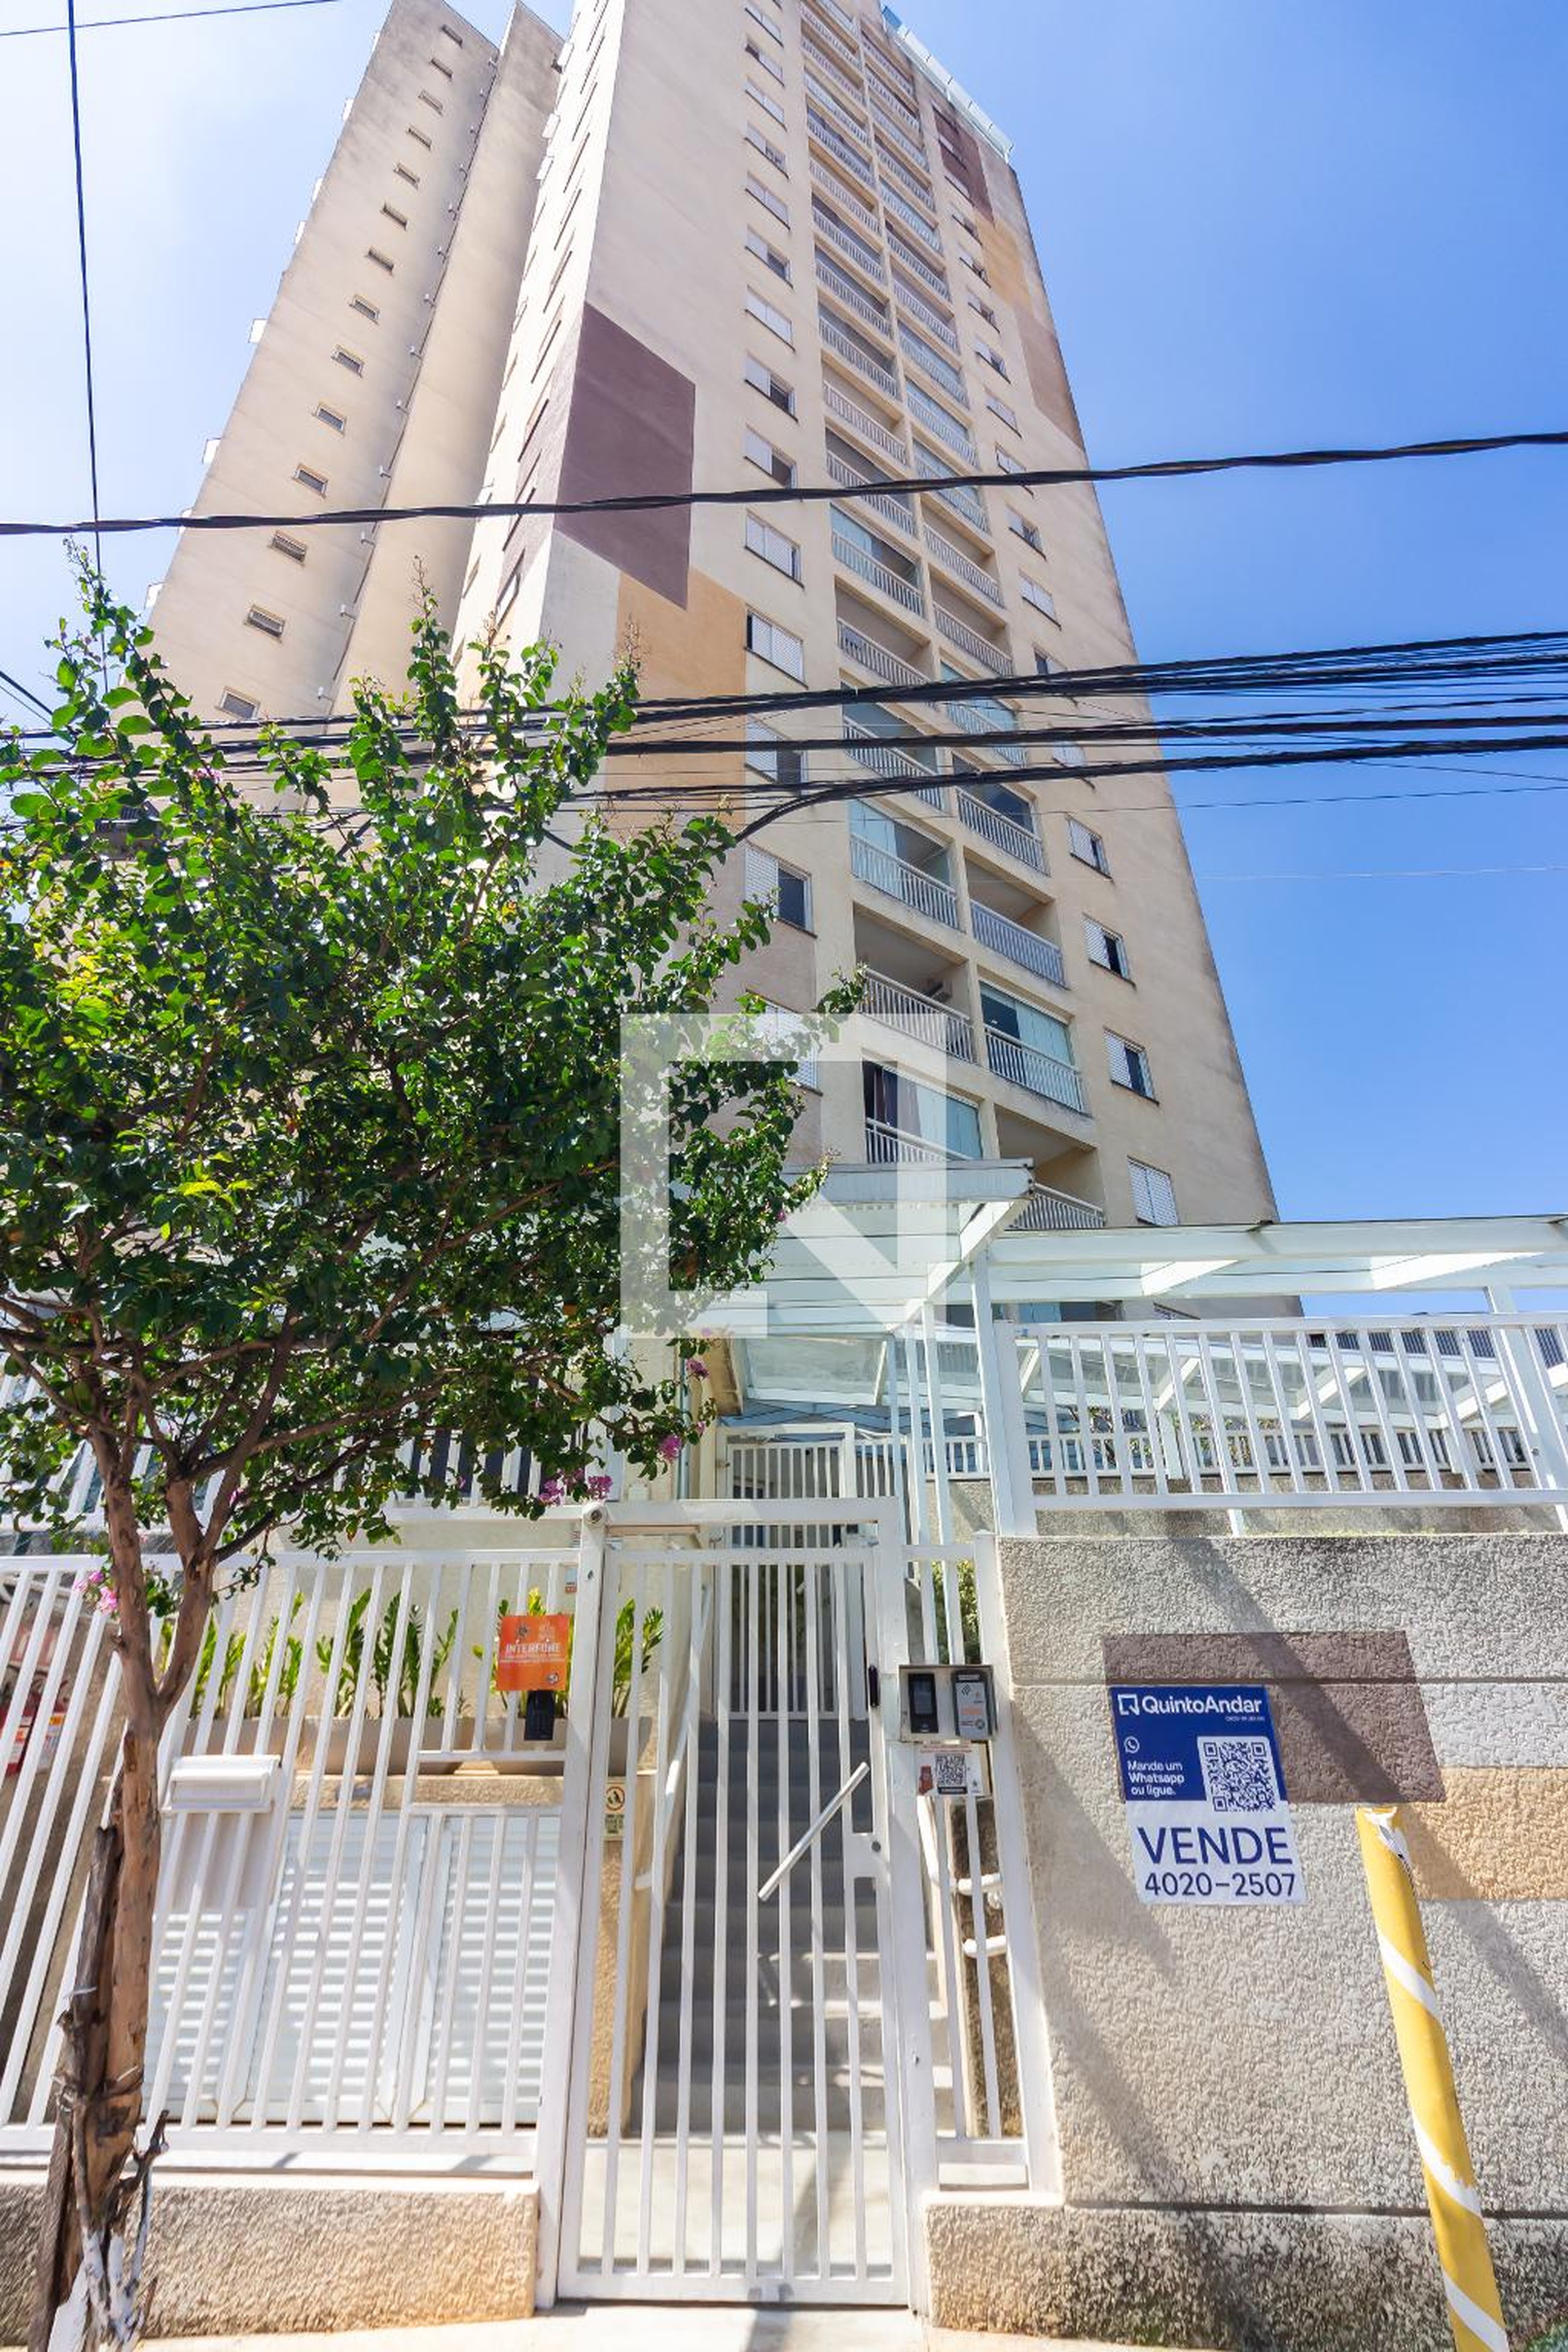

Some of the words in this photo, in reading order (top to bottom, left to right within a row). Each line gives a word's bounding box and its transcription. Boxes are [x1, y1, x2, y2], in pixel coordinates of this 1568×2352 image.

[1142, 1695, 1262, 1714] QuintoAndar
[1127, 1760, 1164, 1771] Mande
[1165, 1762, 1183, 1771] um
[1128, 1772, 1185, 1786] Whatsapp
[1131, 1786, 1145, 1795] ou
[1146, 1784, 1176, 1797] ligue.
[1137, 1826, 1293, 1864] VENDE
[1145, 1872, 1296, 1896] 4020-2507
